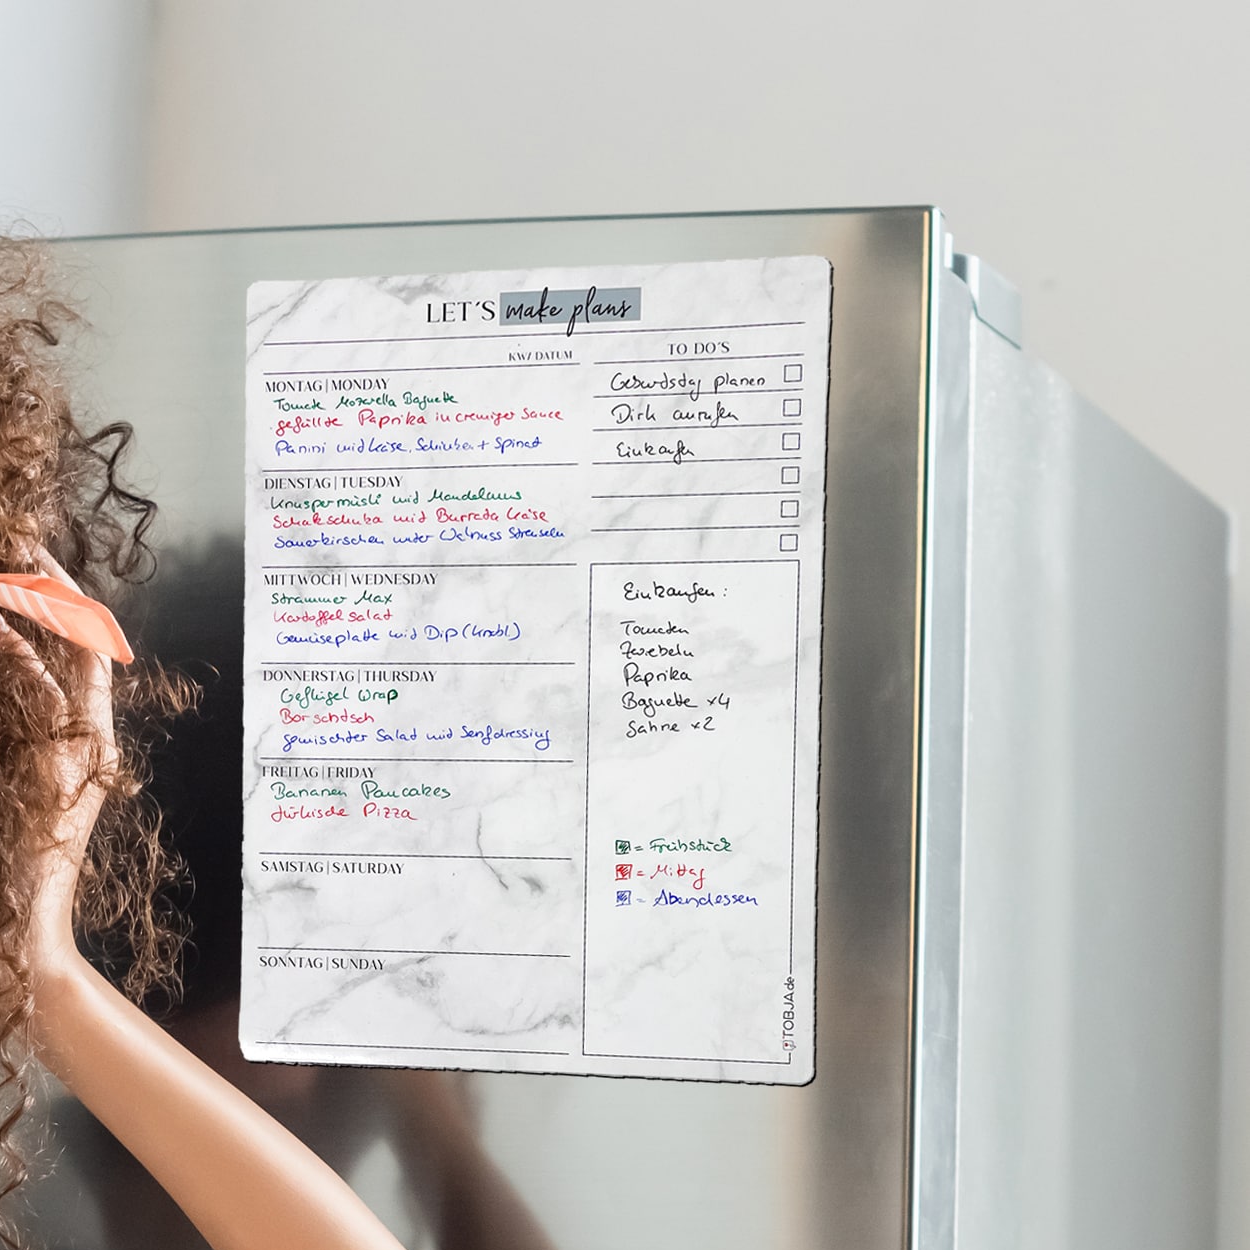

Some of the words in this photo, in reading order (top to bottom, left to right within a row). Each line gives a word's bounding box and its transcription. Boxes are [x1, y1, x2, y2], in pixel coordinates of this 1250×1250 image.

[506, 287, 563, 323] make
[566, 286, 633, 337] plans
[535, 350, 573, 361] DATUM
[667, 343, 688, 356] TO
[714, 372, 765, 394] planen
[403, 391, 458, 411] Baguette
[358, 408, 427, 429] Paprika
[436, 412, 449, 422] in
[521, 407, 564, 420] Sauce
[611, 403, 656, 424] Dirk
[672, 401, 739, 428] anrufen
[275, 440, 326, 456] Panini
[616, 440, 695, 465] Einkaufen
[353, 589, 393, 605] Max
[423, 624, 459, 643] Dip
[623, 662, 692, 687] Paprika
[357, 688, 399, 705] Wrap
[621, 691, 699, 718] Baguette
[707, 693, 730, 710] x4
[626, 720, 680, 738] Sahne
[690, 716, 716, 731] x2
[270, 781, 348, 800] Bananen
[360, 780, 451, 799] Pancakes
[363, 802, 418, 820] Pizza
[652, 888, 760, 908] Abendessen
